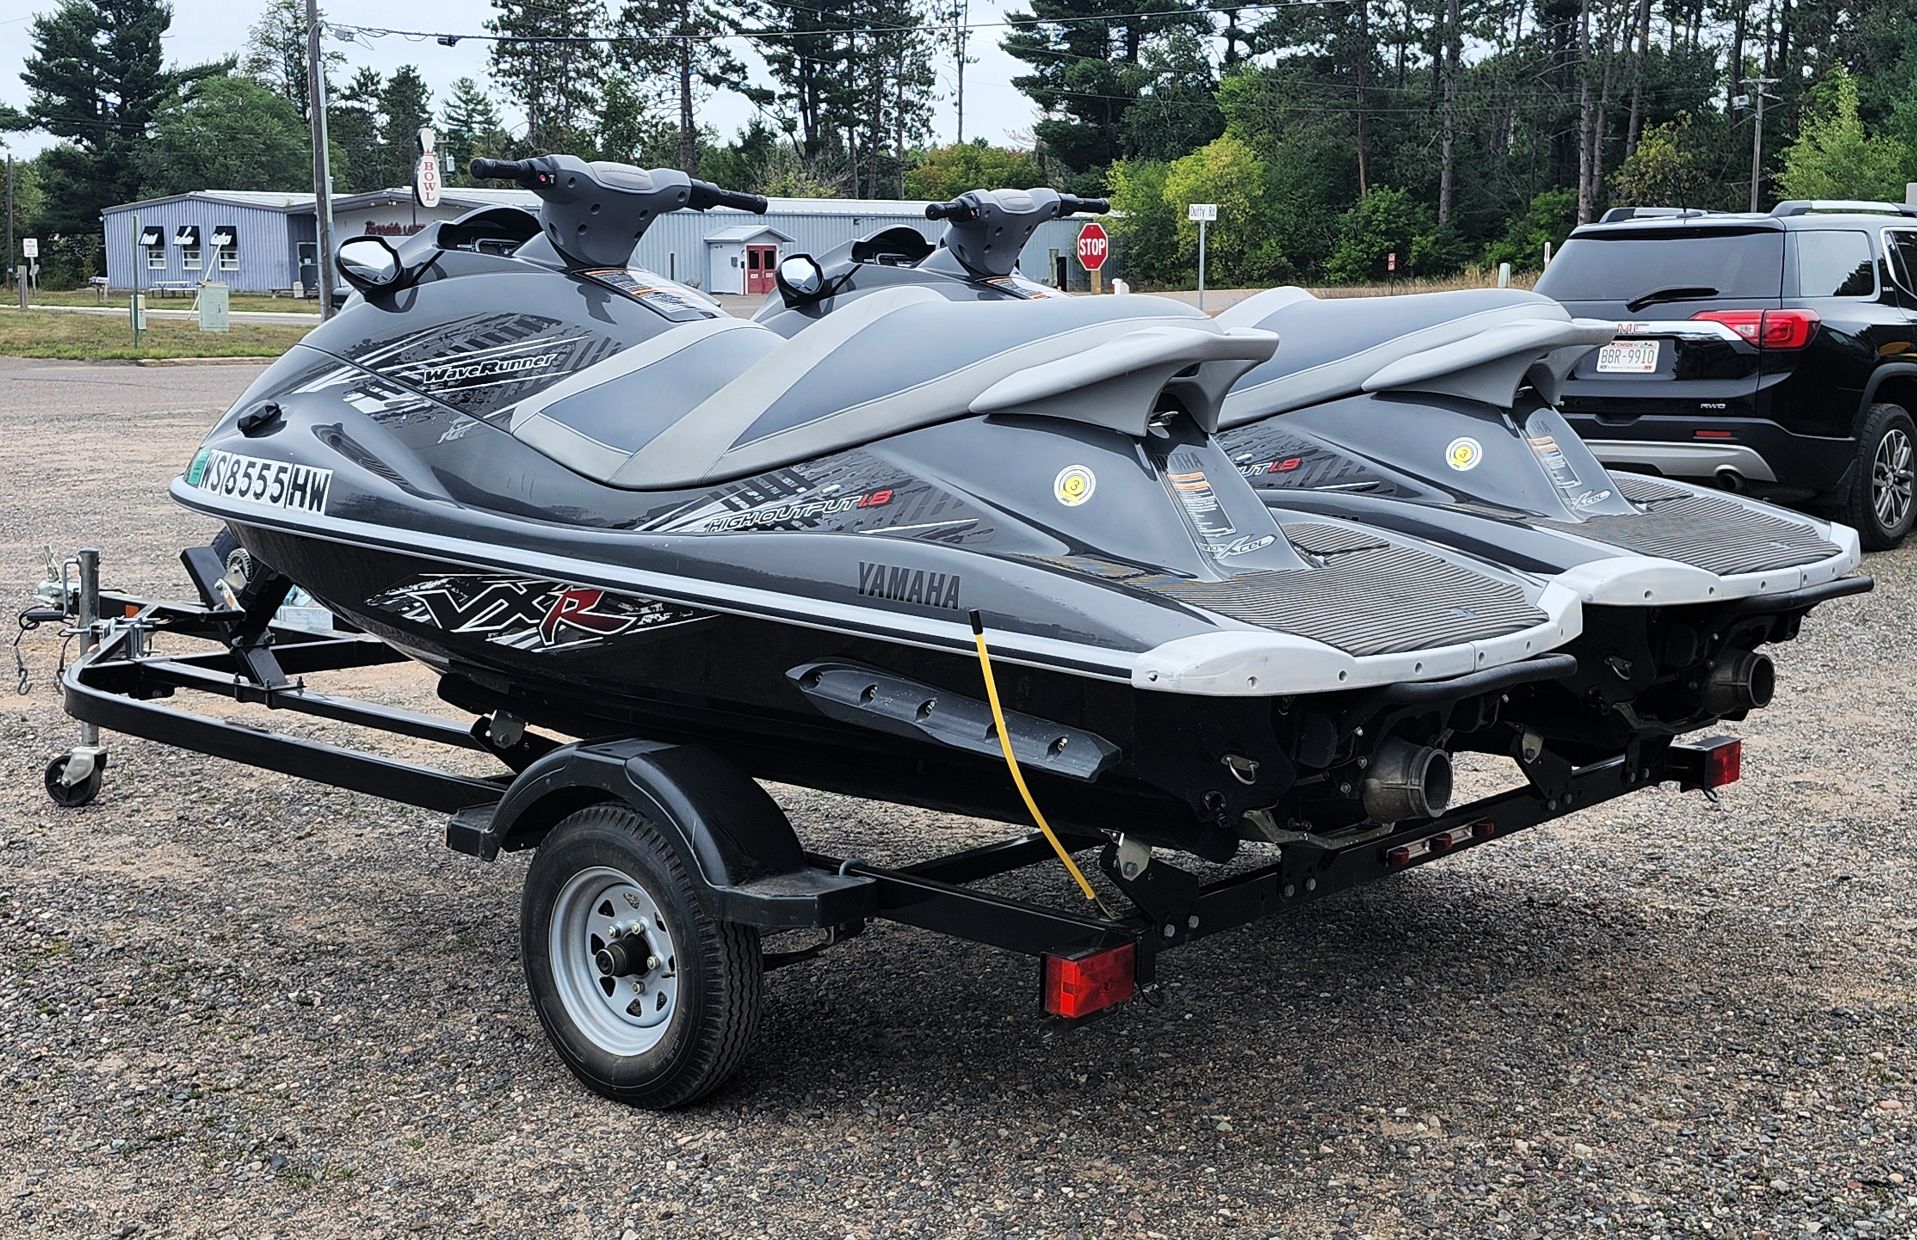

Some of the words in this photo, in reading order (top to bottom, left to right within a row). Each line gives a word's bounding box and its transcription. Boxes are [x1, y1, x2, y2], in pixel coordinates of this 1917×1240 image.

[423, 161, 436, 201] BOWL
[1190, 205, 1205, 218] Duffy
[1208, 205, 1216, 217] Rd
[1079, 238, 1106, 256] STOP
[1616, 323, 1650, 334] MC
[1600, 349, 1655, 364] BBR-9910
[423, 353, 557, 383] WaveRunner
[1459, 448, 1468, 459] 3
[1070, 479, 1080, 491] 3
[858, 560, 960, 611] YAMAHA
[406, 580, 638, 646] VXR
